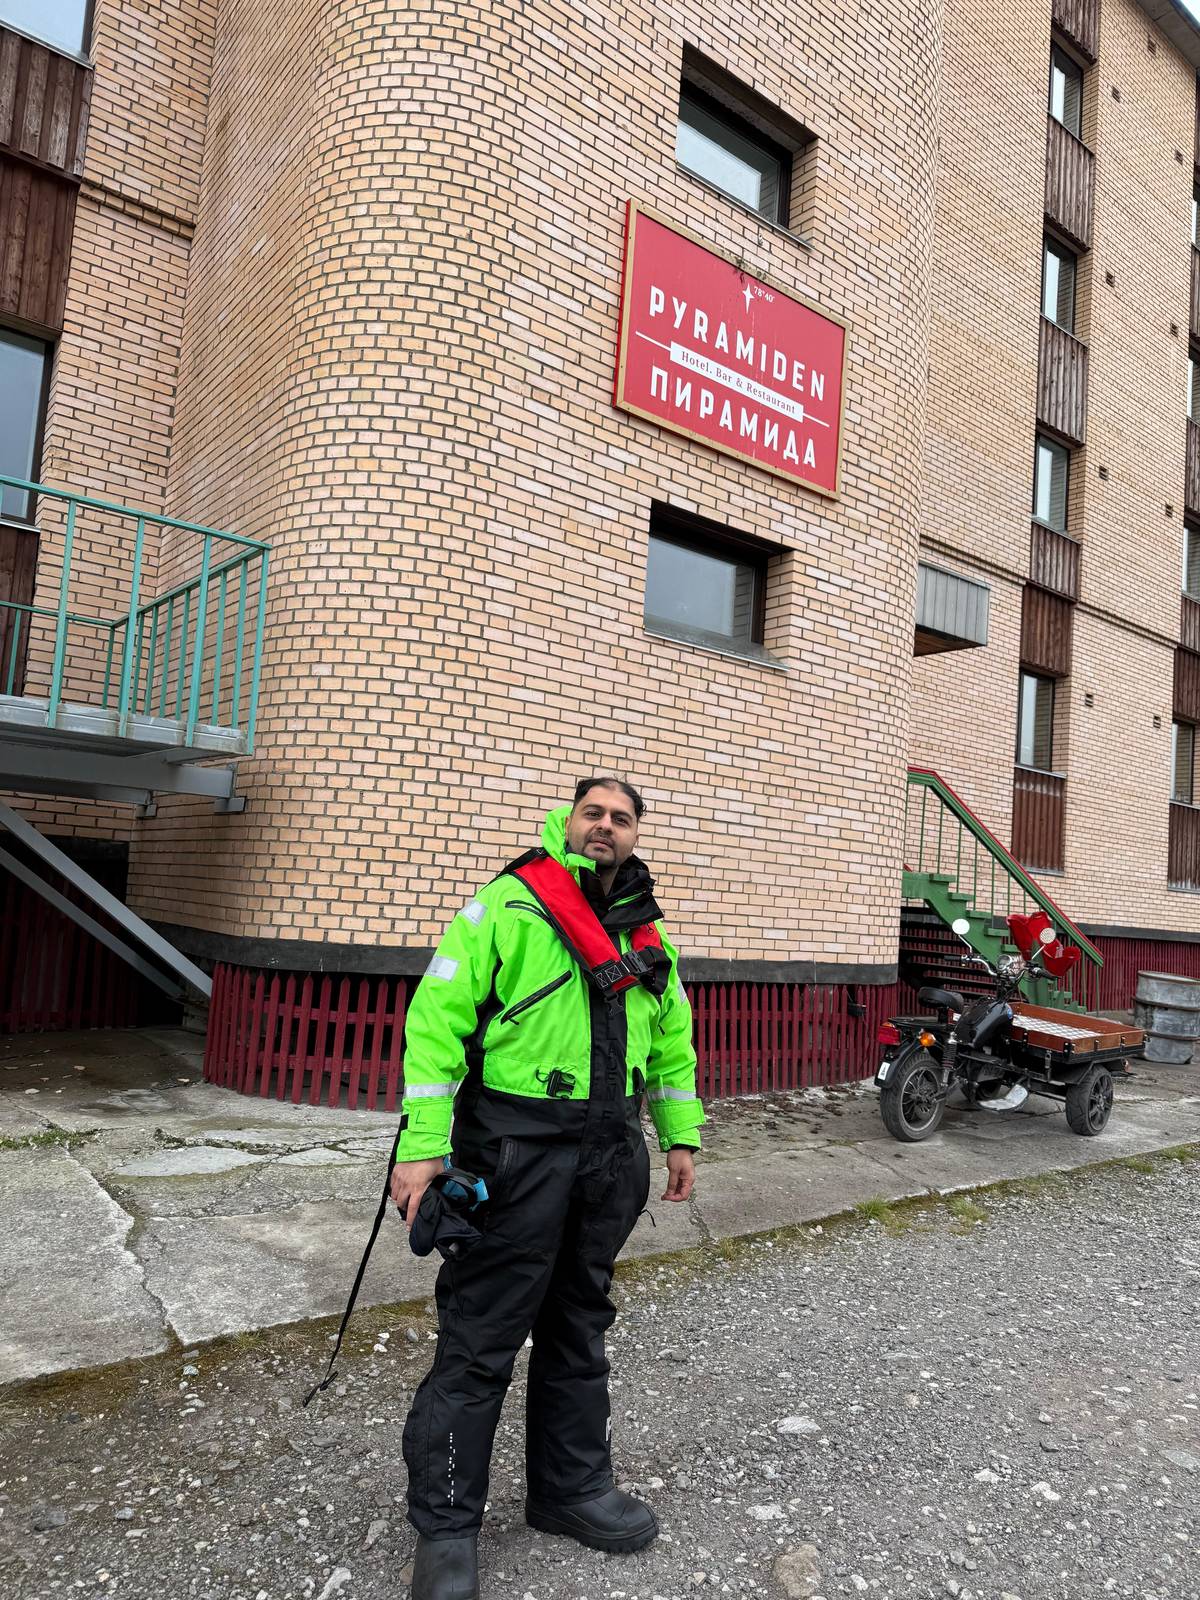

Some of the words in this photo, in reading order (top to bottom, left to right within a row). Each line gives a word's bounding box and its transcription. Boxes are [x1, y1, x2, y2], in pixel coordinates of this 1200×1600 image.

[649, 285, 825, 401] PYRAMIDEN
[716, 367, 732, 383] Bar
[736, 377, 743, 388] &
[747, 382, 795, 414] Restaurant
[650, 365, 816, 468] ПИРАМИДА
